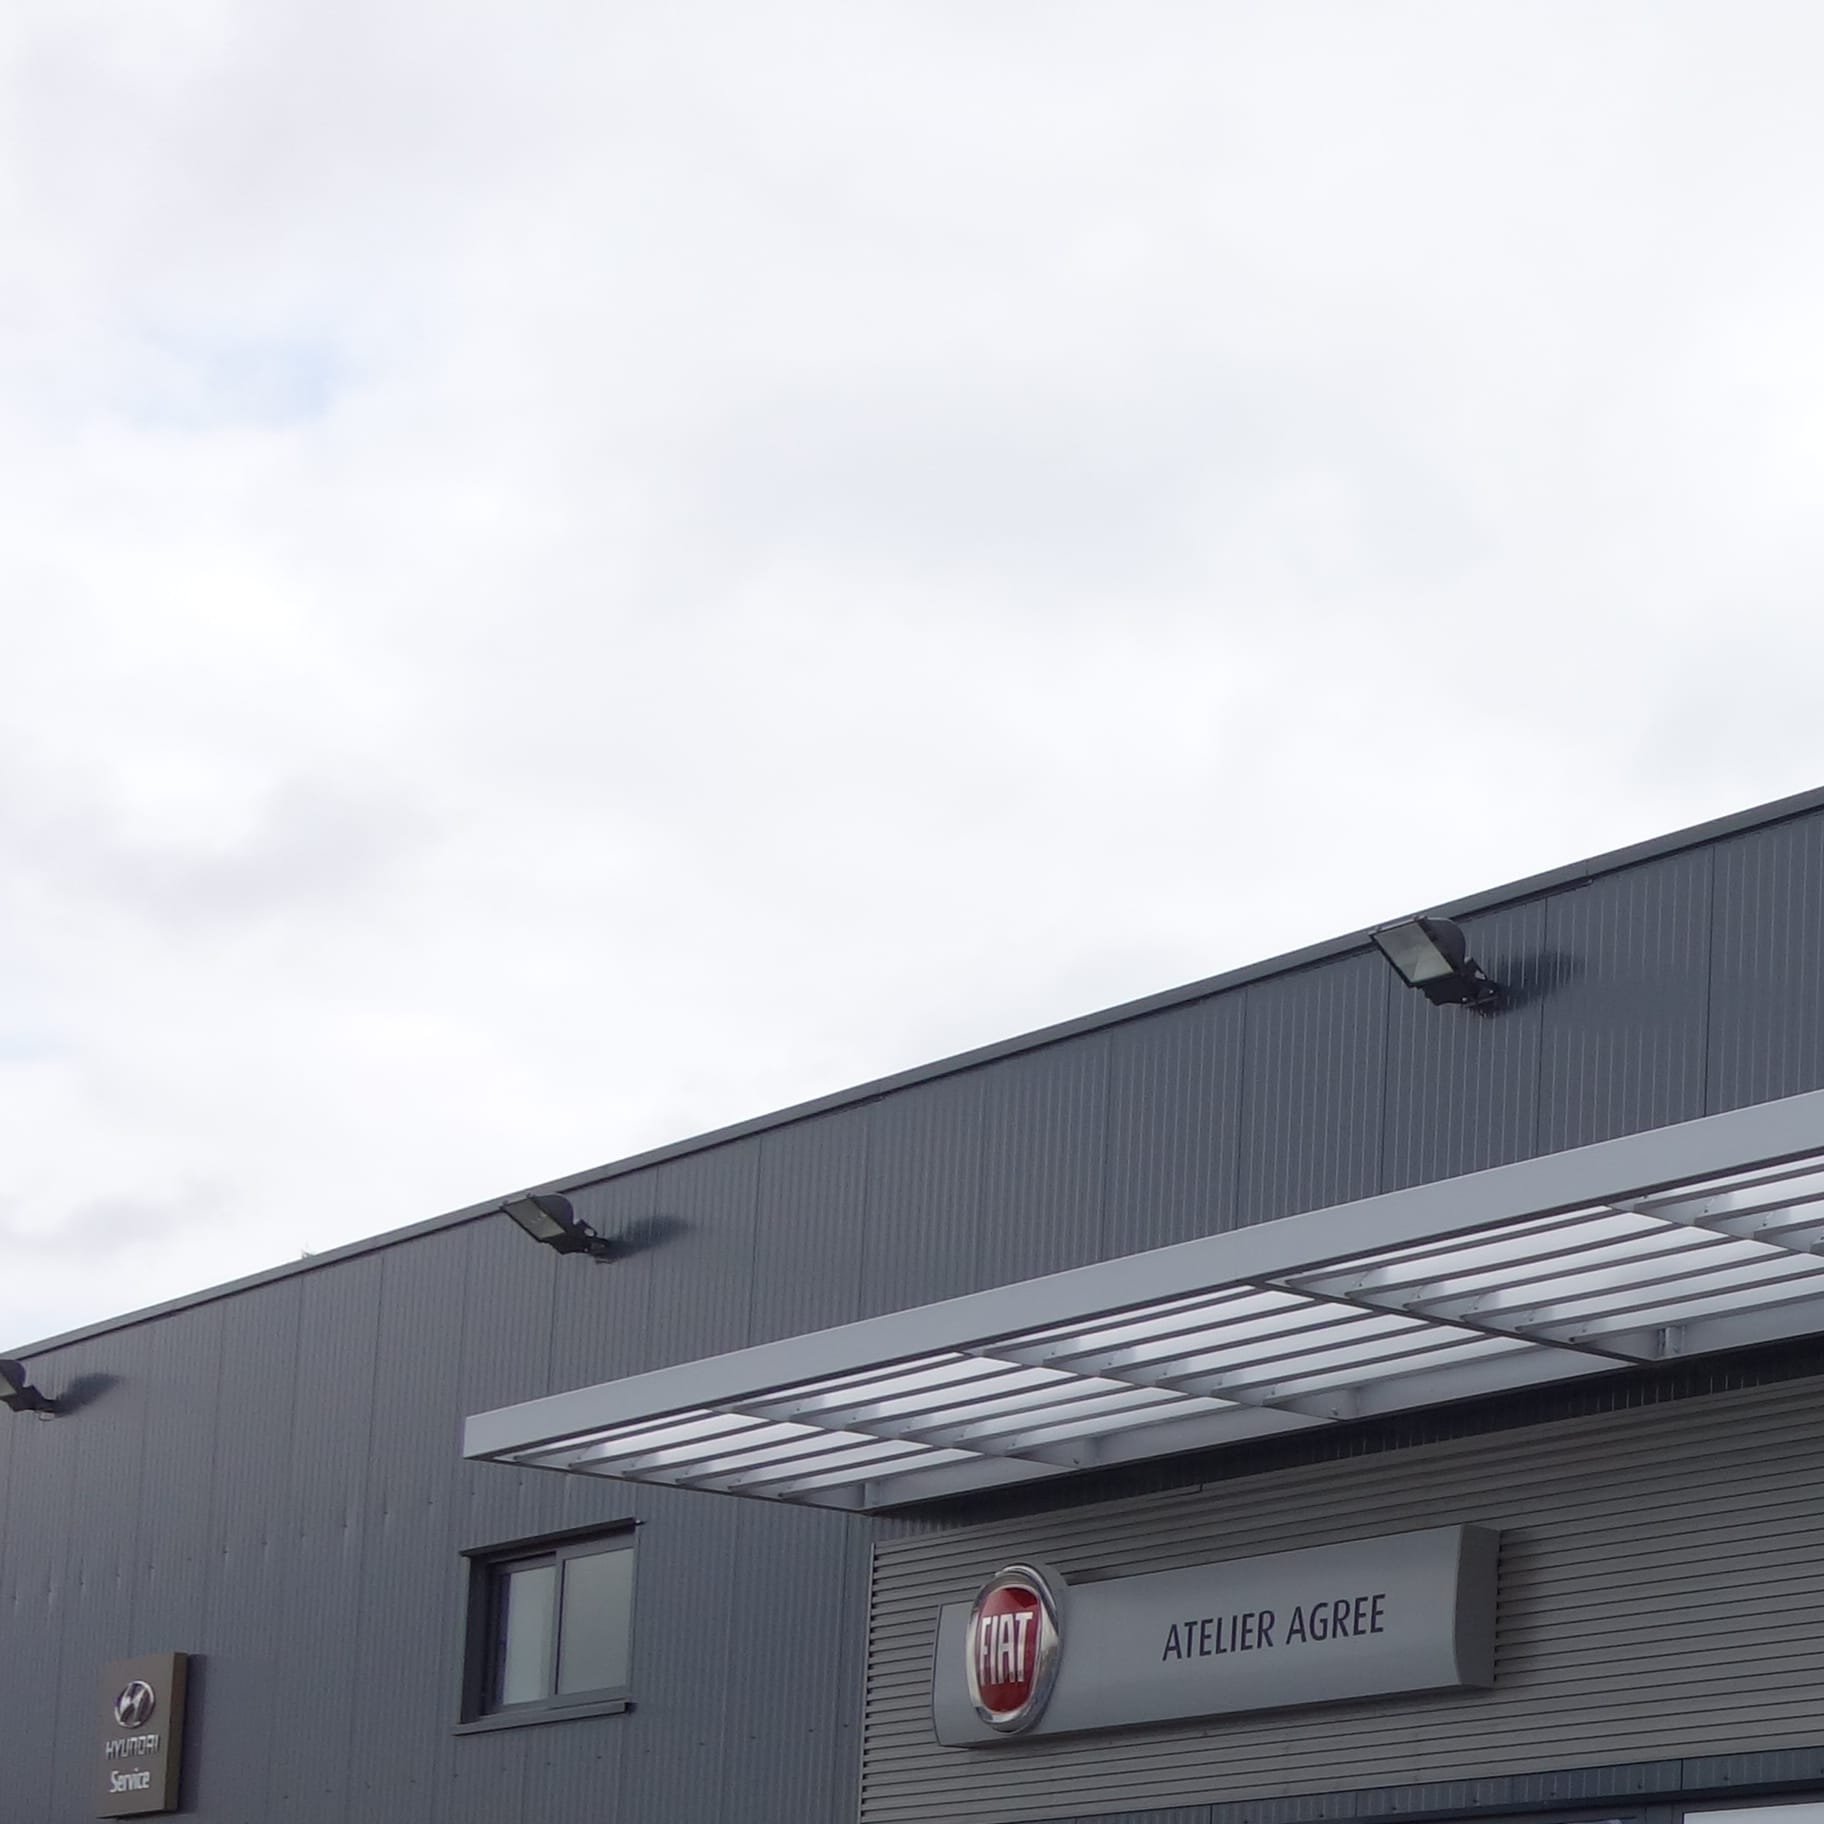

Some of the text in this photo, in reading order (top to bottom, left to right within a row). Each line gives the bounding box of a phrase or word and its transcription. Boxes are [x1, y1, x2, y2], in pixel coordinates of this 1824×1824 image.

[980, 1611, 1034, 1687] FIAT
[1162, 1594, 1386, 1661] ATELIER AGREE
[105, 1734, 160, 1760] HYUNDAI
[109, 1768, 151, 1793] Service
